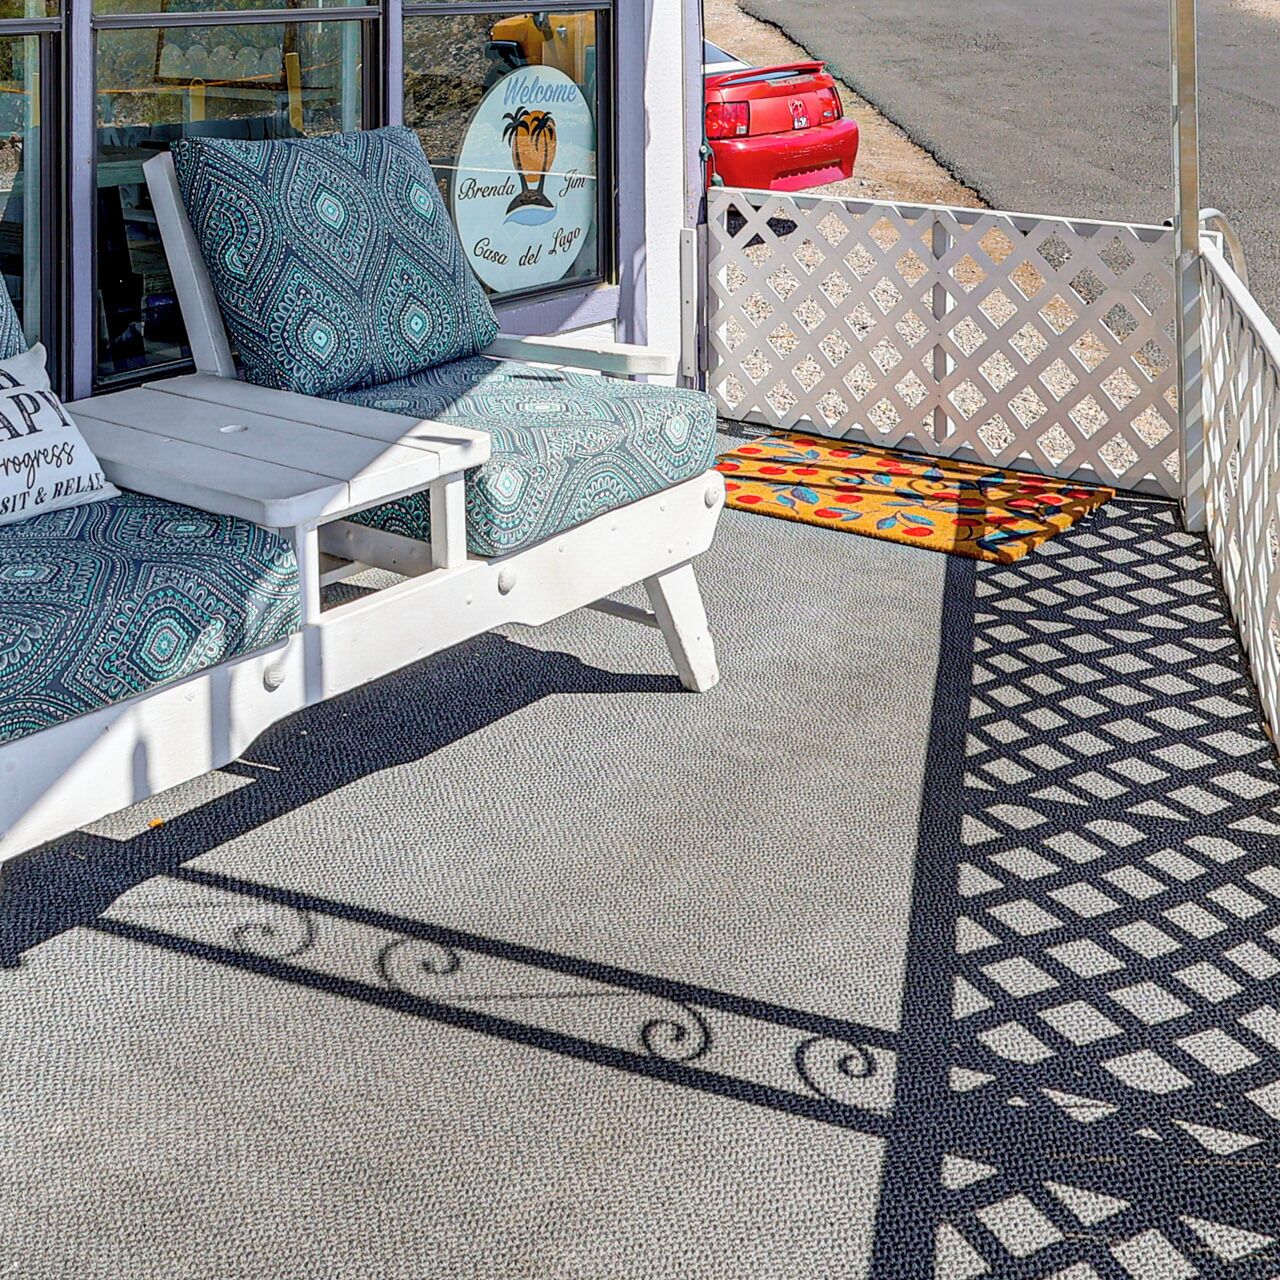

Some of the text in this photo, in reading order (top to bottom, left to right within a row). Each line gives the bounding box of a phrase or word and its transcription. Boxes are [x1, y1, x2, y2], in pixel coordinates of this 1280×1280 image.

[503, 76, 578, 106] Welcome
[457, 168, 587, 200] Brenda Jim
[473, 226, 581, 268] Casa del Lago
[35, 485, 48, 505] &
[53, 472, 105, 501] RELAX
